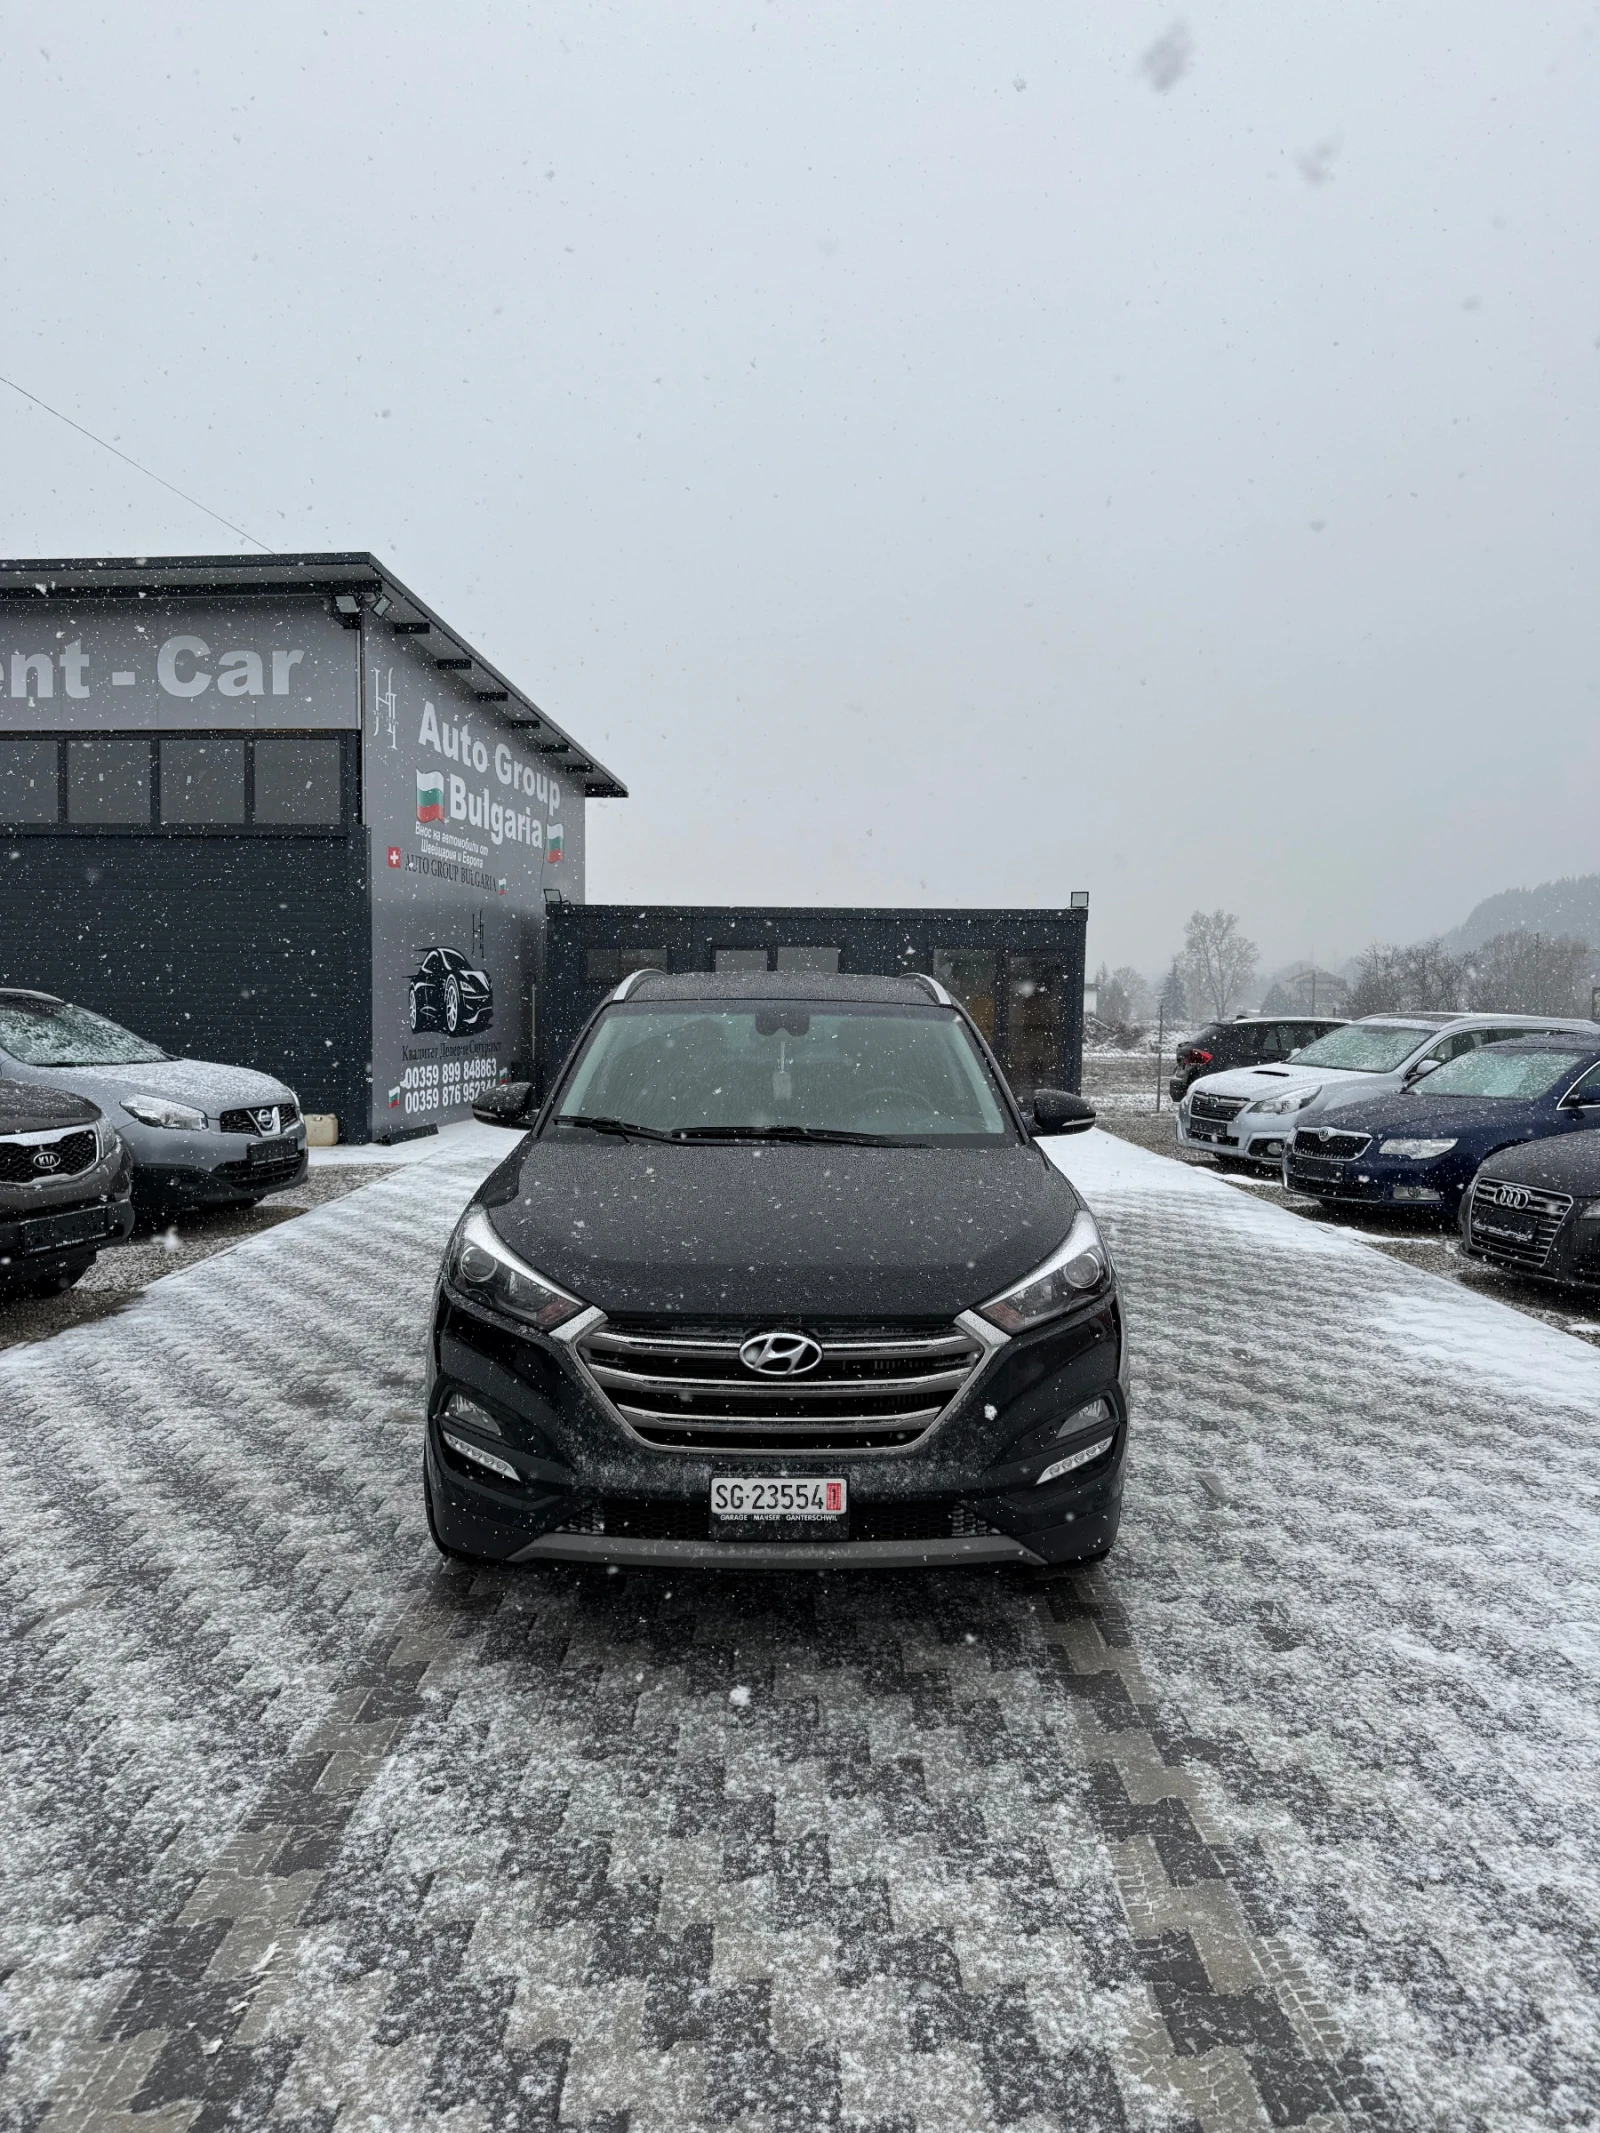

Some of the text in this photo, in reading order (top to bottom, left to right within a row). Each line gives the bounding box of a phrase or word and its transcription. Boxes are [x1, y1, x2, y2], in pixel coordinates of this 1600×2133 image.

[0, 639, 90, 699] nt
[157, 635, 305, 698] Car
[418, 701, 560, 816] Auto Group
[450, 774, 542, 848] Bulgaria
[415, 821, 432, 839] Внос
[405, 853, 497, 892] AUTO GROUP BULGARIA
[405, 1057, 497, 1089] 00359 899 848863
[405, 1088, 439, 1114] 00359
[442, 1084, 460, 1106] 876
[38, 1154, 57, 1166] KIA
